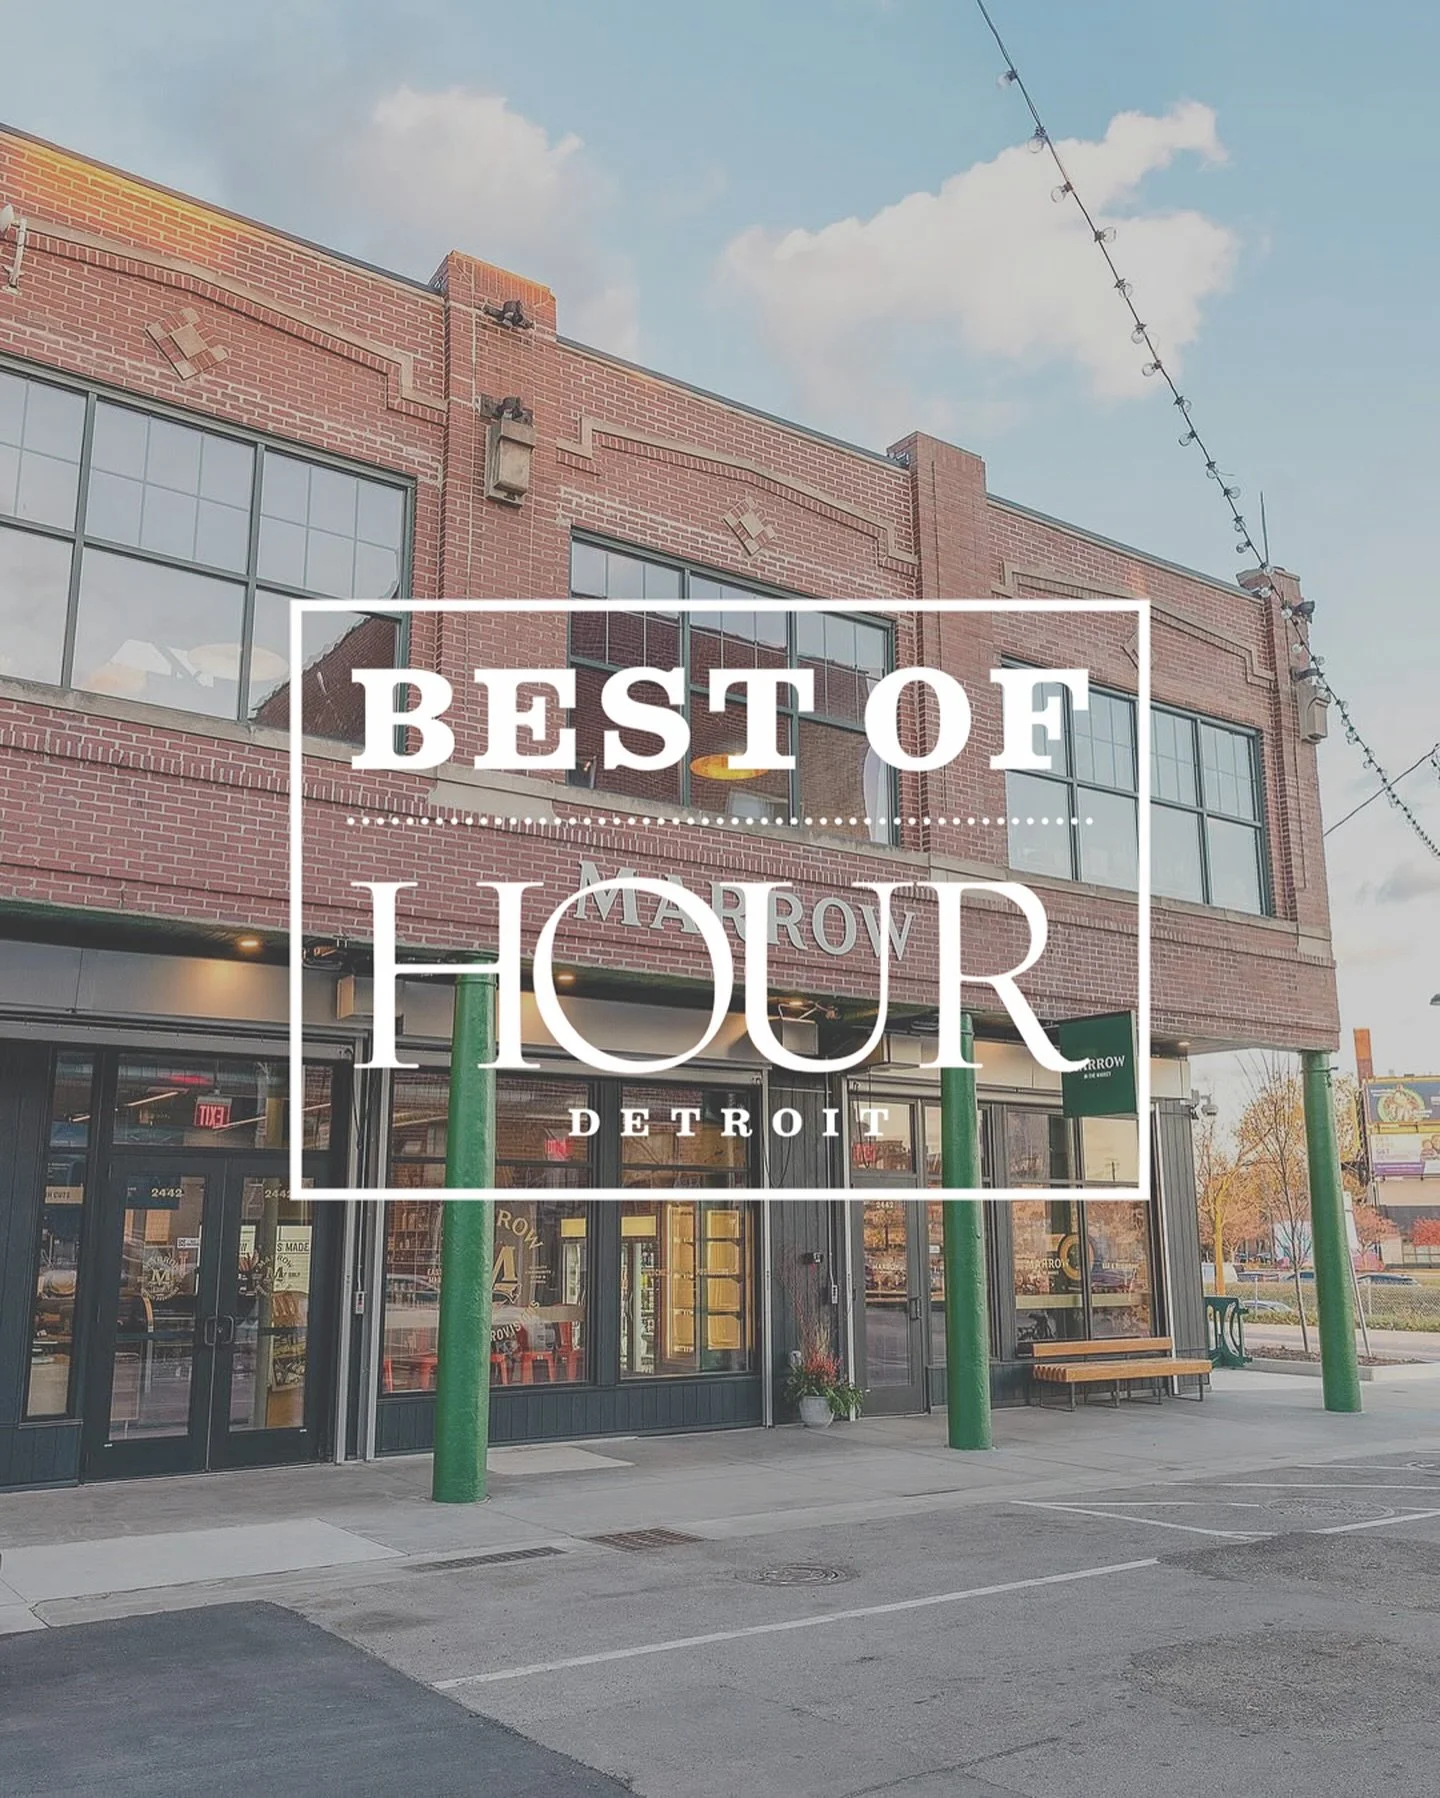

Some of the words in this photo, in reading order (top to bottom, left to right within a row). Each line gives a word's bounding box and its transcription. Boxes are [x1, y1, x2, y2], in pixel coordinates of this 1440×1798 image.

[572, 860, 915, 961] MARROW
[1081, 1055, 1125, 1071] RROW
[151, 1187, 183, 1198] 2442
[497, 1209, 544, 1250] ROW
[285, 1242, 310, 1252] MADE
